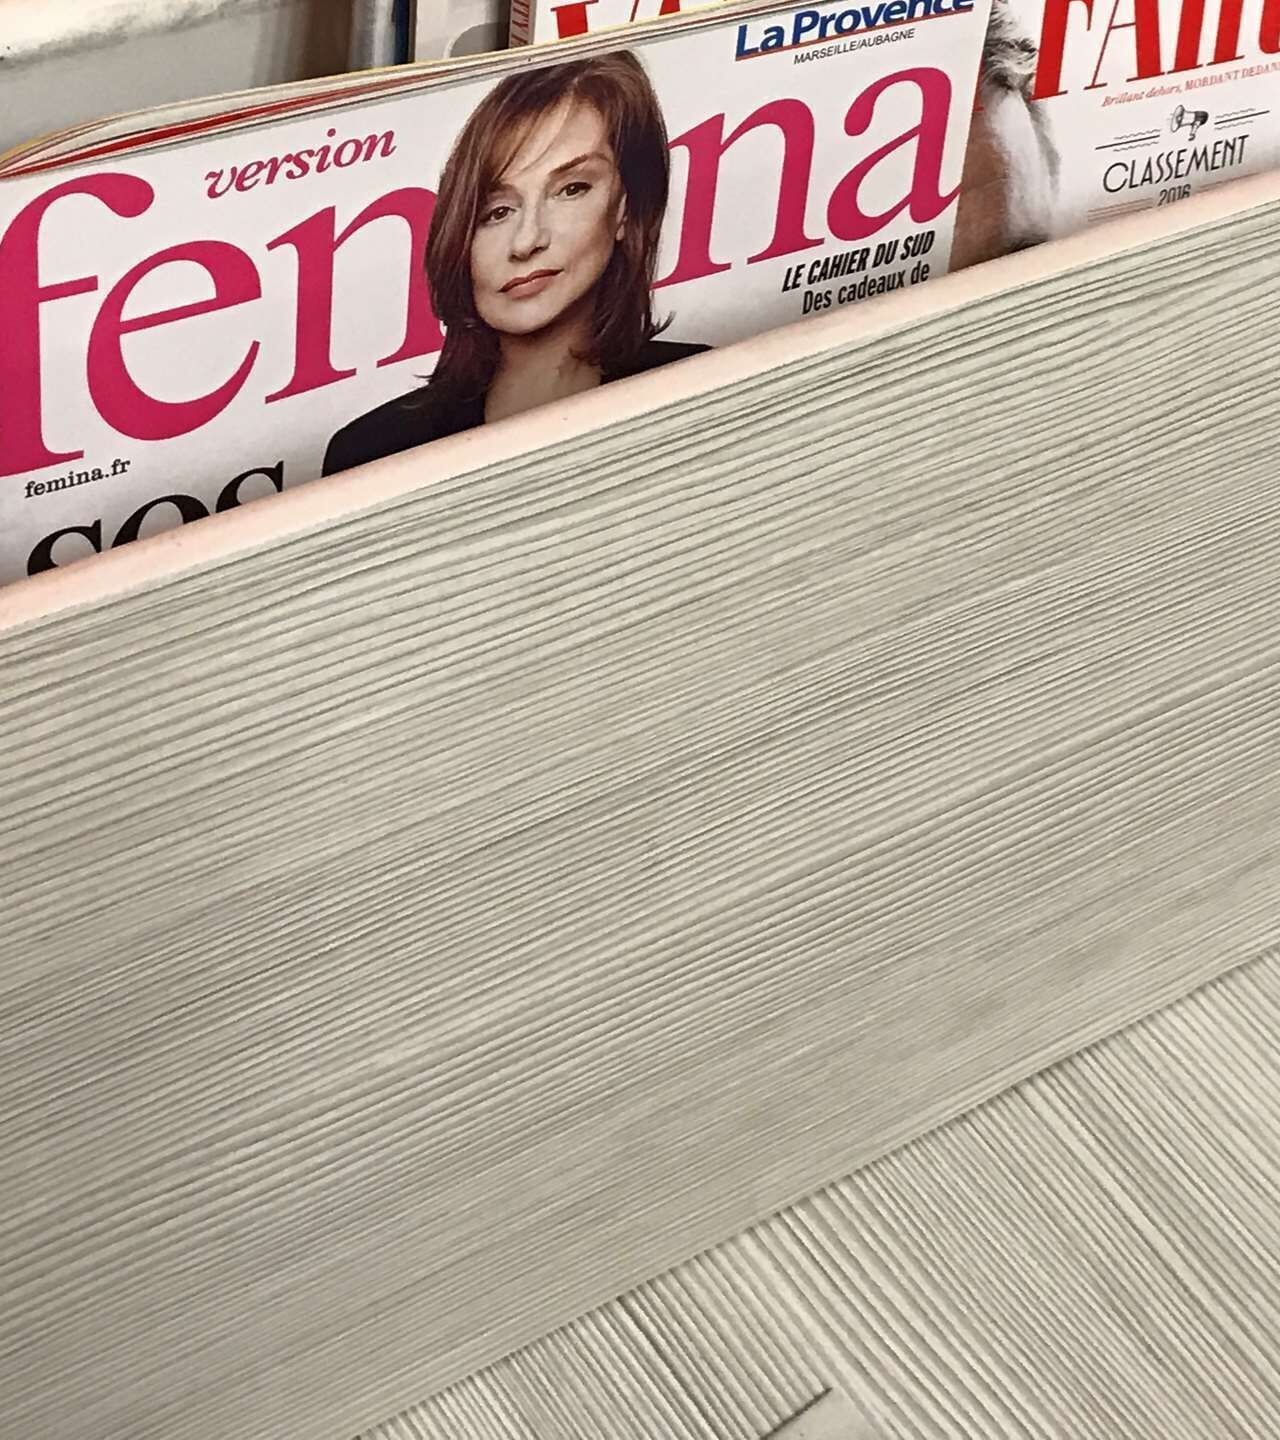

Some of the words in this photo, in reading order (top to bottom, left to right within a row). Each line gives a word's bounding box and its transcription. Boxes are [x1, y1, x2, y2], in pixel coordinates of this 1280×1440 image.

[734, 22, 786, 57] La
[792, 27, 916, 65] MARSEILLE/AUBAGNE
[1184, 70, 1241, 92] MORDANT
[204, 128, 398, 200] version
[1102, 134, 1251, 194] CLASSEMENT
[782, 266, 805, 293] LE
[806, 252, 869, 289] CAHIER
[870, 241, 897, 271] DU
[898, 230, 937, 260] SUD
[801, 286, 834, 315] Des
[836, 269, 907, 307] cadeaux
[910, 260, 931, 286] de
[23, 457, 131, 500] femina.fr
